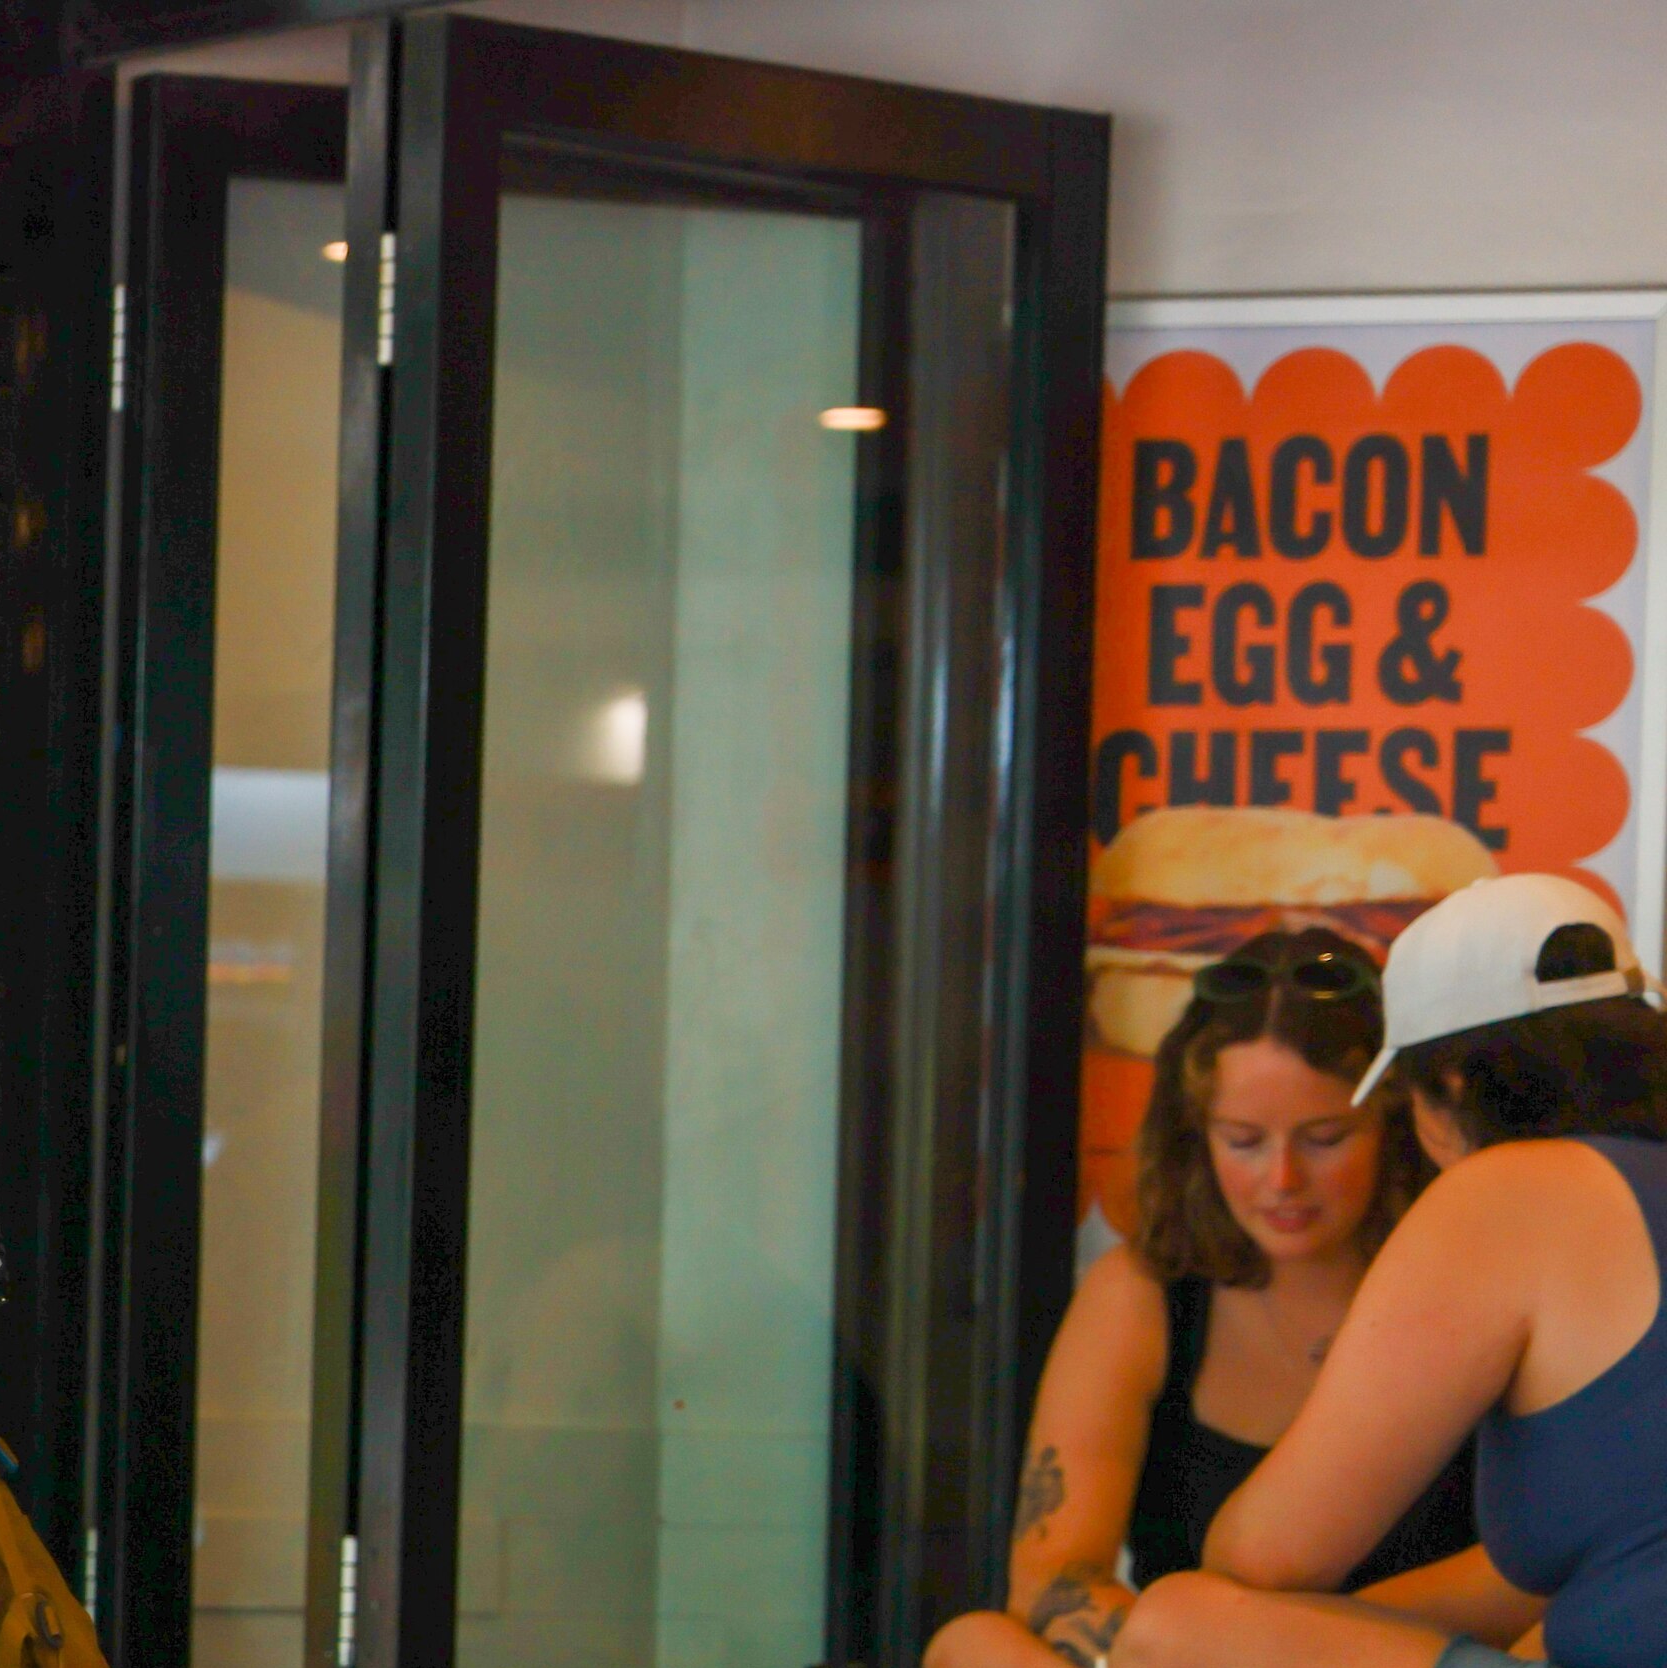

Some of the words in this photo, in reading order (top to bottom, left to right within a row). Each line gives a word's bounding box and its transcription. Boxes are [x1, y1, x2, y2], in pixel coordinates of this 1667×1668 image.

[1130, 432, 1489, 561] BACON
[1147, 579, 1353, 708] EGG
[1376, 579, 1464, 706] &
[1092, 726, 1512, 851] CHEESE
